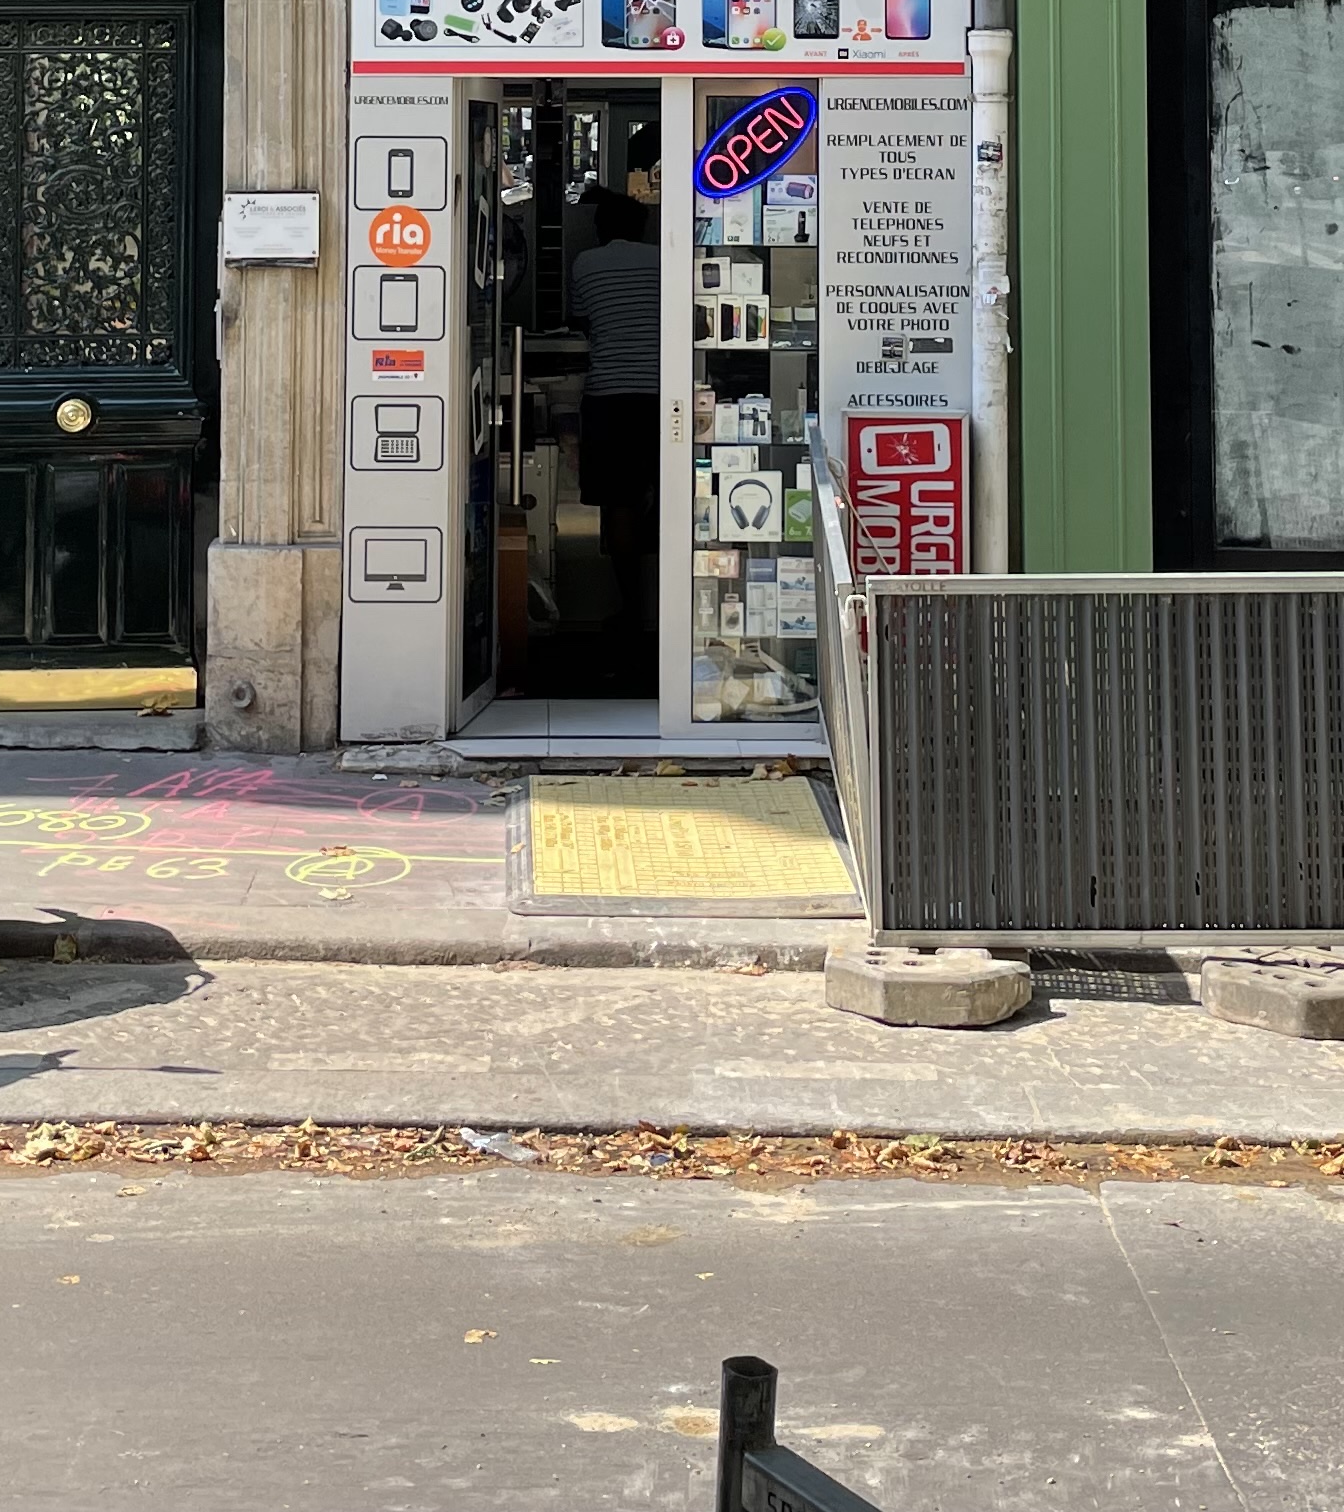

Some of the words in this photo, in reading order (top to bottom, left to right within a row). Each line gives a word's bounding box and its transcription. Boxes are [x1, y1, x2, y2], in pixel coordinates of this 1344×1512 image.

[852, 50, 886, 59] Xiaomi
[827, 98, 968, 111] URGENCEMOBILES.COM
[705, 96, 805, 189] OPEN
[827, 135, 944, 147] REMPLACEMENT
[950, 135, 967, 147] DE
[879, 151, 917, 163] TOUS
[840, 168, 888, 180] TYPES
[893, 168, 956, 180] D'ECRAN
[862, 201, 910, 214] VENTE
[914, 201, 933, 214] DE
[376, 213, 424, 244] ria
[852, 218, 944, 230] TELEPHONES
[863, 235, 909, 247] NEUFS
[914, 235, 932, 247] ET
[376, 247, 397, 255] Money
[837, 251, 959, 264] RECONDITIONNES
[826, 285, 970, 297] PERSONNALISATION
[836, 302, 855, 314] DE
[860, 302, 917, 315] COQUES
[922, 302, 960, 314] AVEC
[847, 318, 896, 331] VOTRE
[901, 318, 950, 331] PHOTO
[847, 394, 949, 407] ACCESSOIRES
[146, 856, 231, 880] 63
